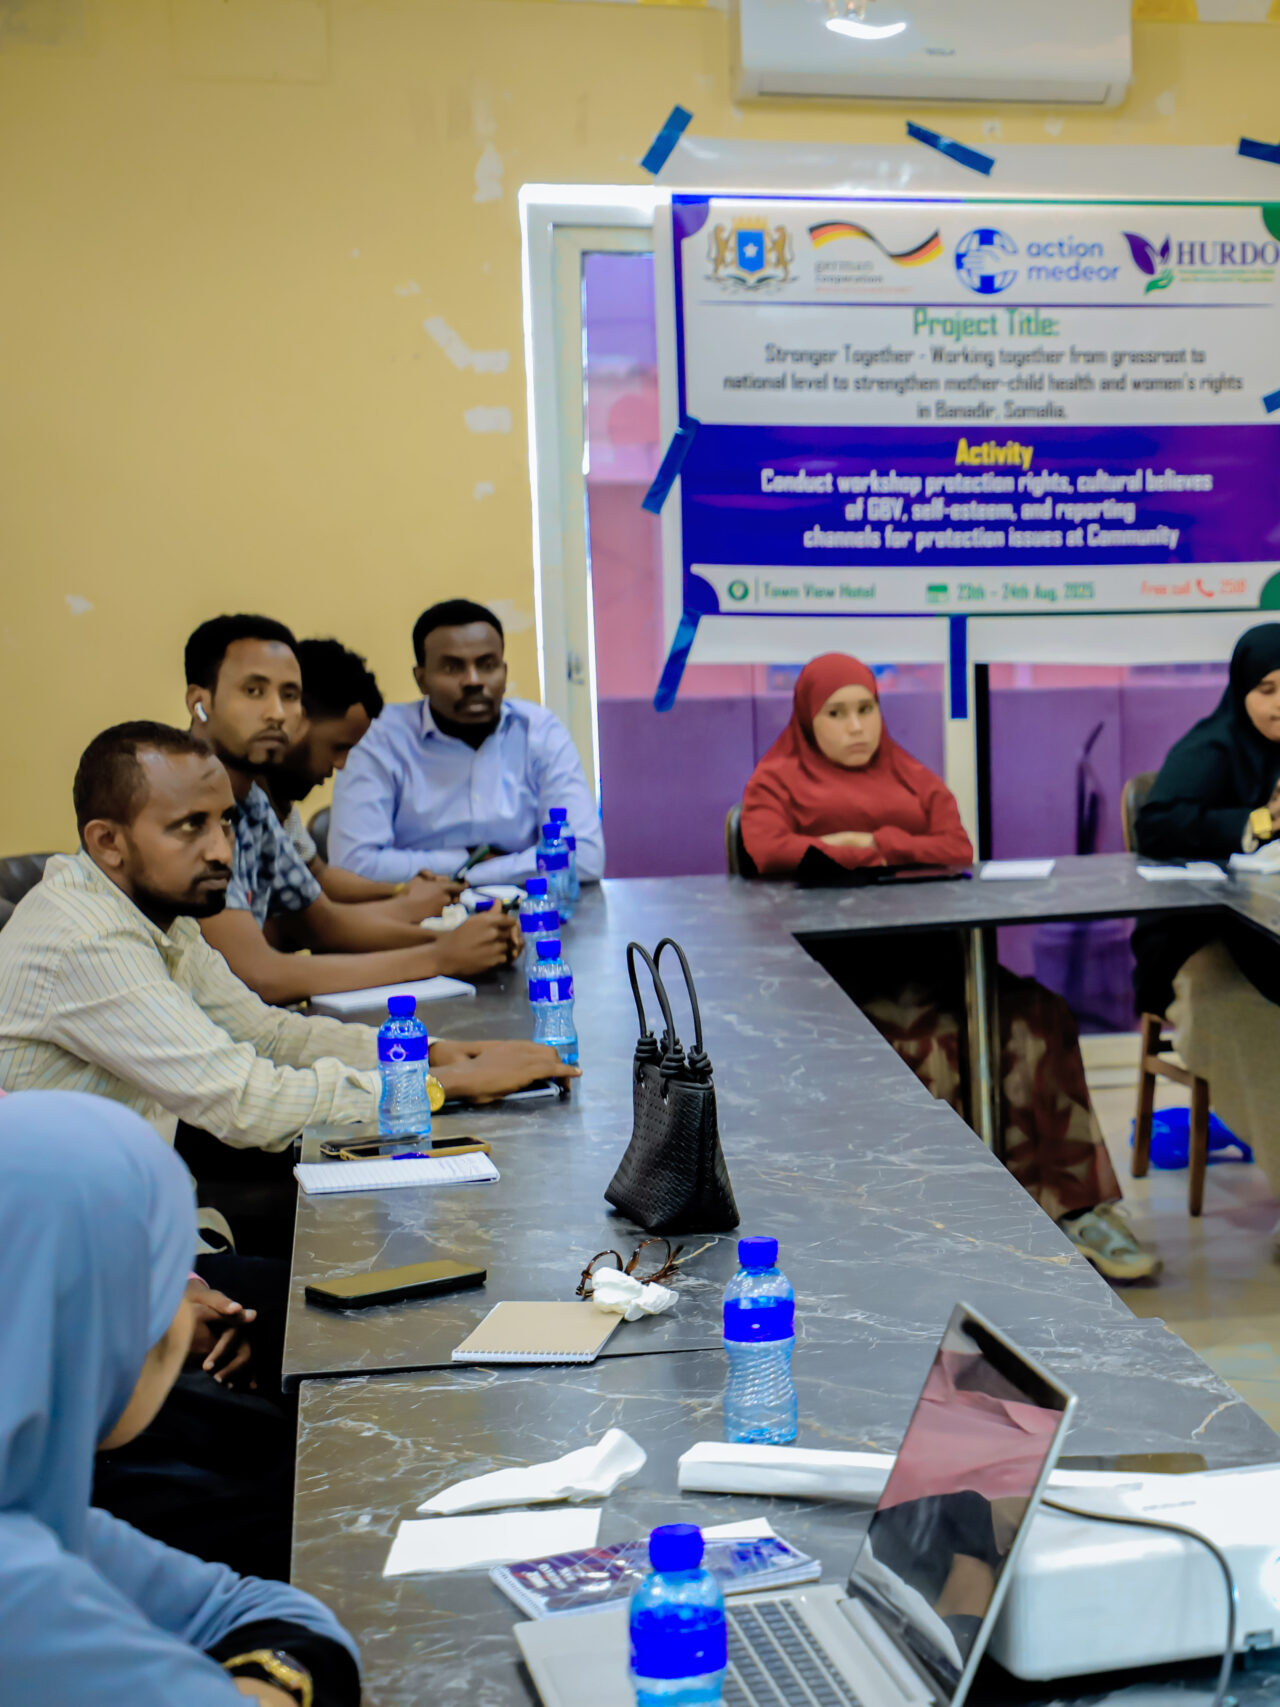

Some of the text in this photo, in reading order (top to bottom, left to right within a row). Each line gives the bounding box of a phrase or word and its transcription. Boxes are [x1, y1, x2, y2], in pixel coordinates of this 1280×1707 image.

[1026, 235, 1104, 258] action
[1176, 240, 1280, 265] HURDO
[1026, 262, 1121, 282] medeor
[912, 307, 1060, 342] Project Title:
[764, 343, 837, 366] Stronger
[844, 344, 914, 367] Together
[931, 344, 995, 367] Working
[1000, 344, 1065, 367] together
[1070, 344, 1107, 364] from
[1111, 347, 1187, 367] grassroot
[1191, 347, 1206, 364] to
[723, 371, 1244, 395] national level to strengthen mother-child health and women's rights
[916, 399, 1069, 420] in Banadir, Somalia.
[955, 437, 1034, 471] Activity
[760, 467, 1214, 498] Conduct workshop protection rights, cultural believes
[844, 496, 1136, 524] of GBV, self-esteem, and reporting
[803, 522, 1180, 553] channels for protection issues at Community
[839, 582, 877, 598] Hotel
